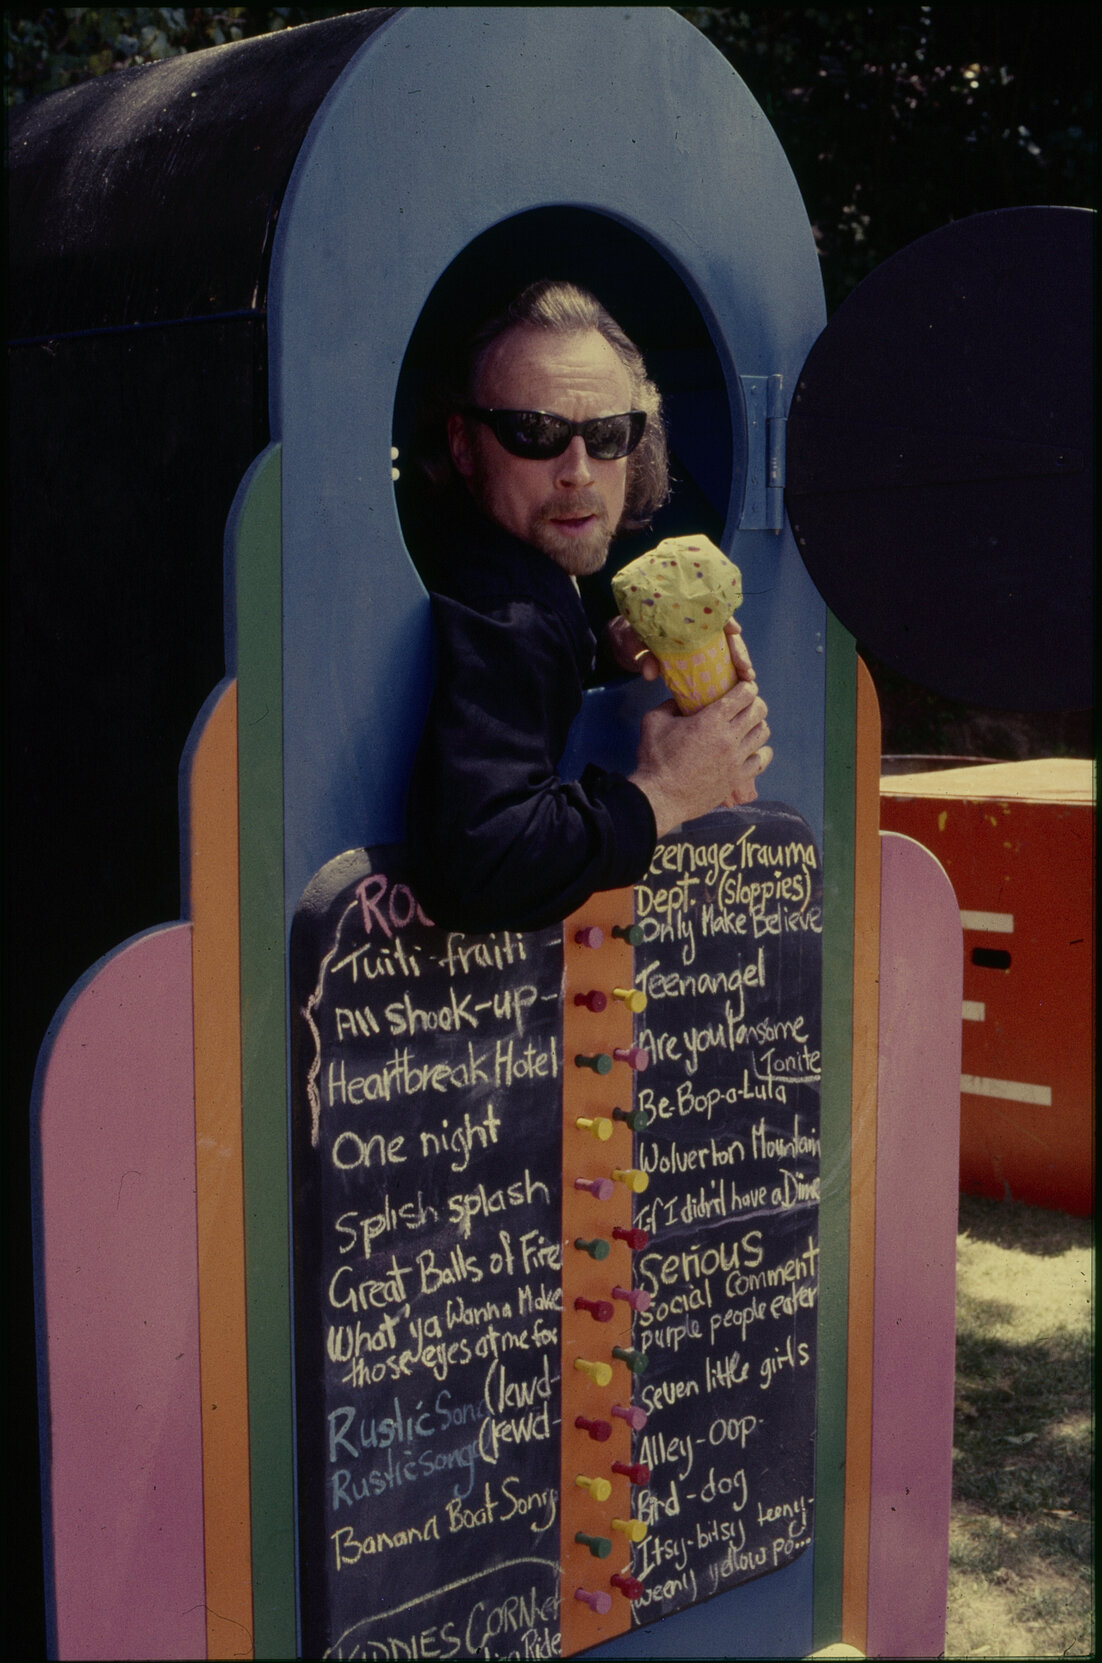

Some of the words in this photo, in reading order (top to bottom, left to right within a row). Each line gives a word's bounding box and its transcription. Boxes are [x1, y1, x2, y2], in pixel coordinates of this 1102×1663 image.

[643, 843, 737, 886] eenage
[737, 825, 817, 869] Trauma
[634, 872, 700, 925] Dept.
[638, 910, 695, 965] Only
[702, 904, 748, 938] Make
[750, 903, 823, 939] Believe
[335, 1006, 380, 1042] All
[638, 1029, 682, 1066] Are
[684, 1023, 727, 1076] you
[328, 1042, 492, 1107] Heartbreak
[495, 1035, 558, 1089] Hotel
[760, 1045, 822, 1080] Tonite
[332, 1131, 408, 1169] One
[420, 1104, 501, 1172] night
[640, 1139, 745, 1174] Wolverton
[752, 1114, 821, 1160] Mountain
[732, 1181, 768, 1212] have
[771, 1191, 783, 1206] a
[779, 1168, 820, 1210] Dime
[335, 1191, 439, 1260] Splish
[328, 1255, 412, 1313] Great
[416, 1244, 484, 1294] Balls
[490, 1230, 514, 1275] of
[520, 1229, 562, 1275] Fire
[726, 1236, 820, 1297] Comment
[410, 1316, 442, 1361] ya
[518, 1283, 563, 1316] Make
[641, 1314, 703, 1354] purple
[711, 1297, 767, 1345] people
[770, 1282, 818, 1319] eater
[421, 1339, 472, 1381] eyes
[475, 1324, 501, 1357] at
[501, 1330, 530, 1351] me
[705, 1351, 750, 1392] little
[760, 1335, 809, 1389] girls
[328, 1397, 435, 1463] Rustic
[331, 1449, 418, 1509] Rustic
[330, 1516, 441, 1571] Banana
[445, 1482, 499, 1533] Boat
[500, 1476, 558, 1533] Song
[709, 1541, 767, 1594] yellow
